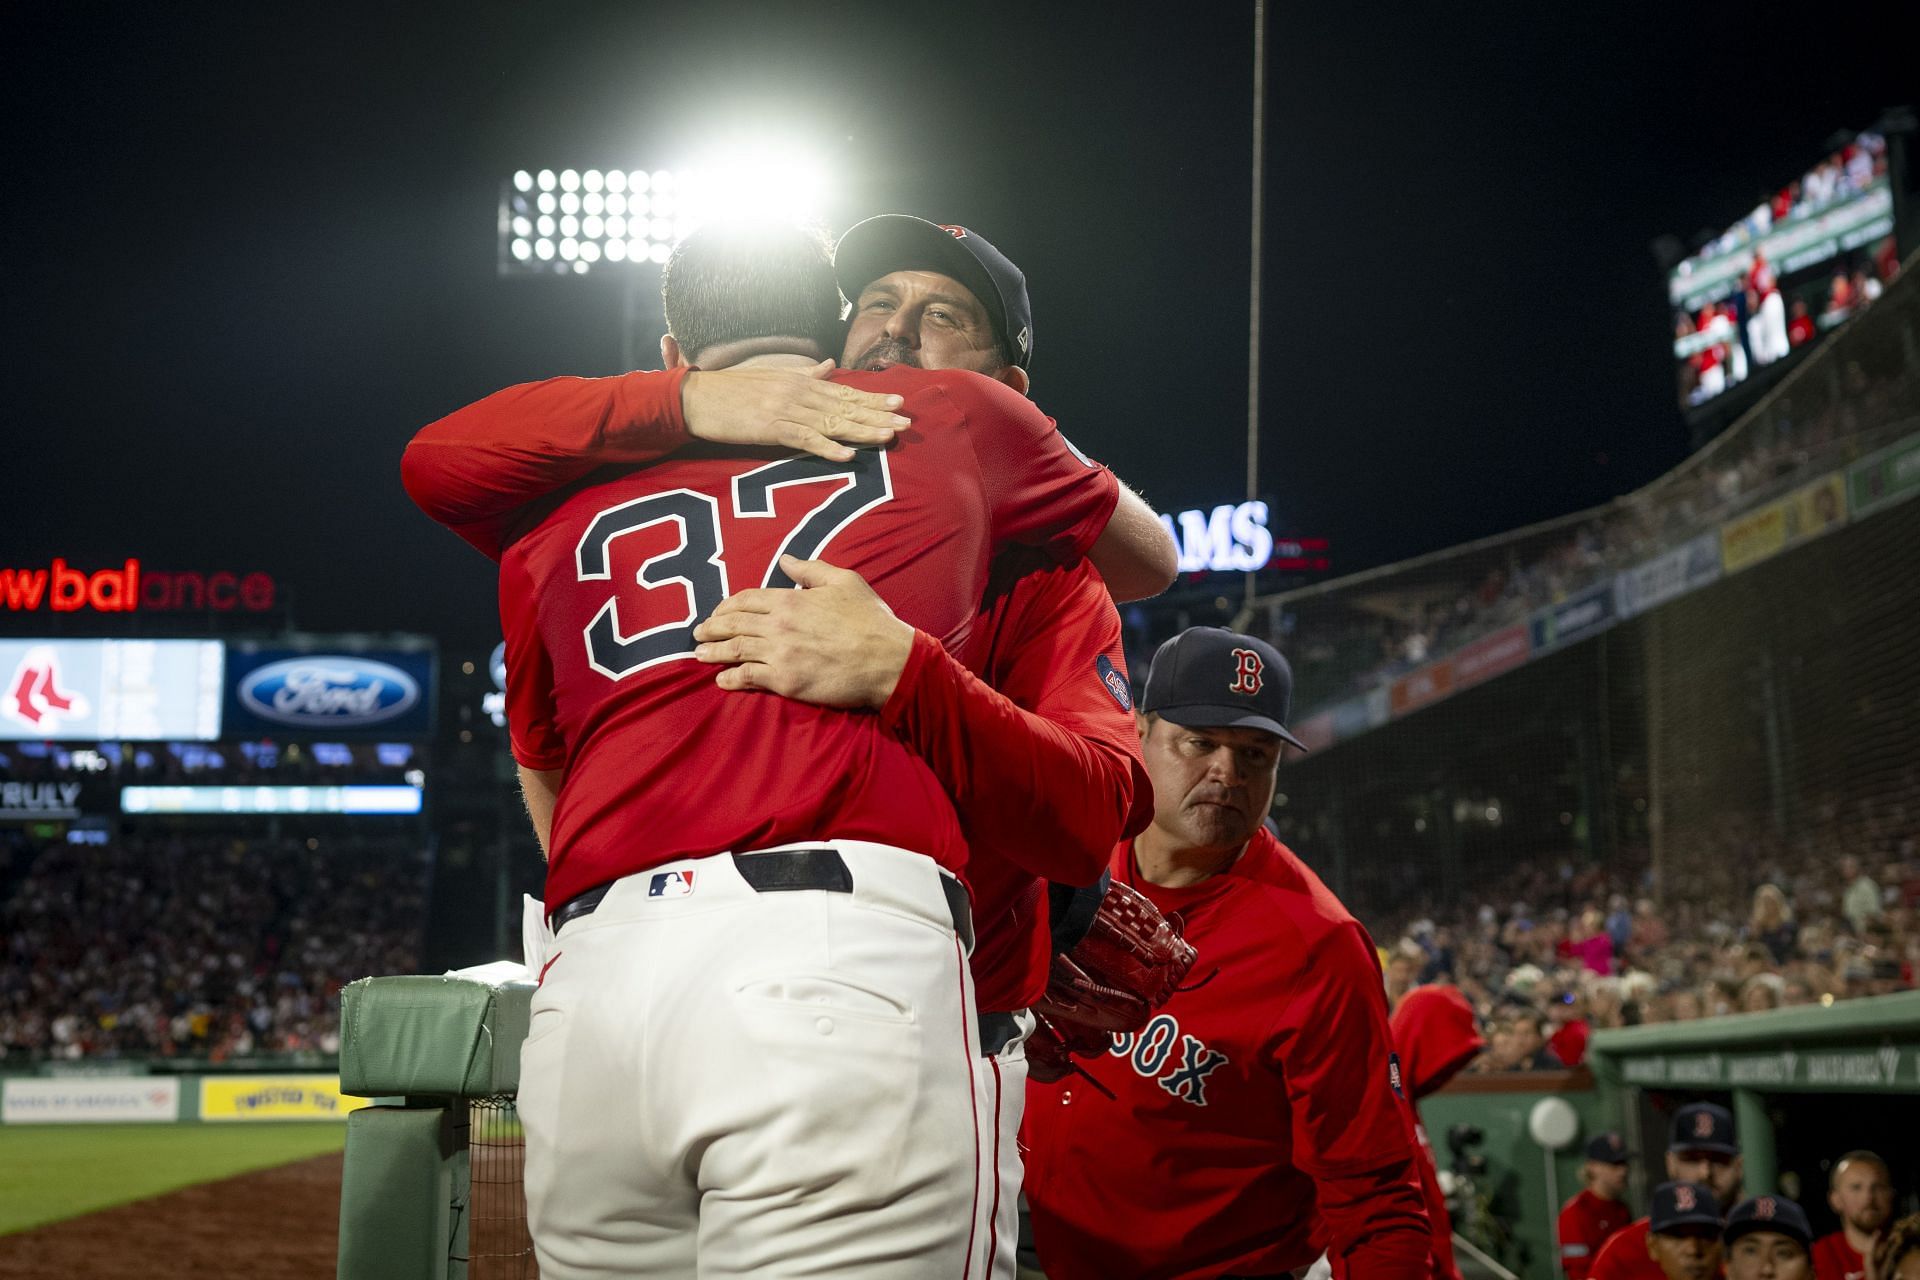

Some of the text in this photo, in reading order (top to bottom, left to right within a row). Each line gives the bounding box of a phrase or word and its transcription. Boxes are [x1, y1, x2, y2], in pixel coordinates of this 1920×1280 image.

[575, 445, 894, 681] 37
[273, 667, 384, 716] Ford
[1229, 648, 1265, 696] B
[0, 781, 81, 811] RULY
